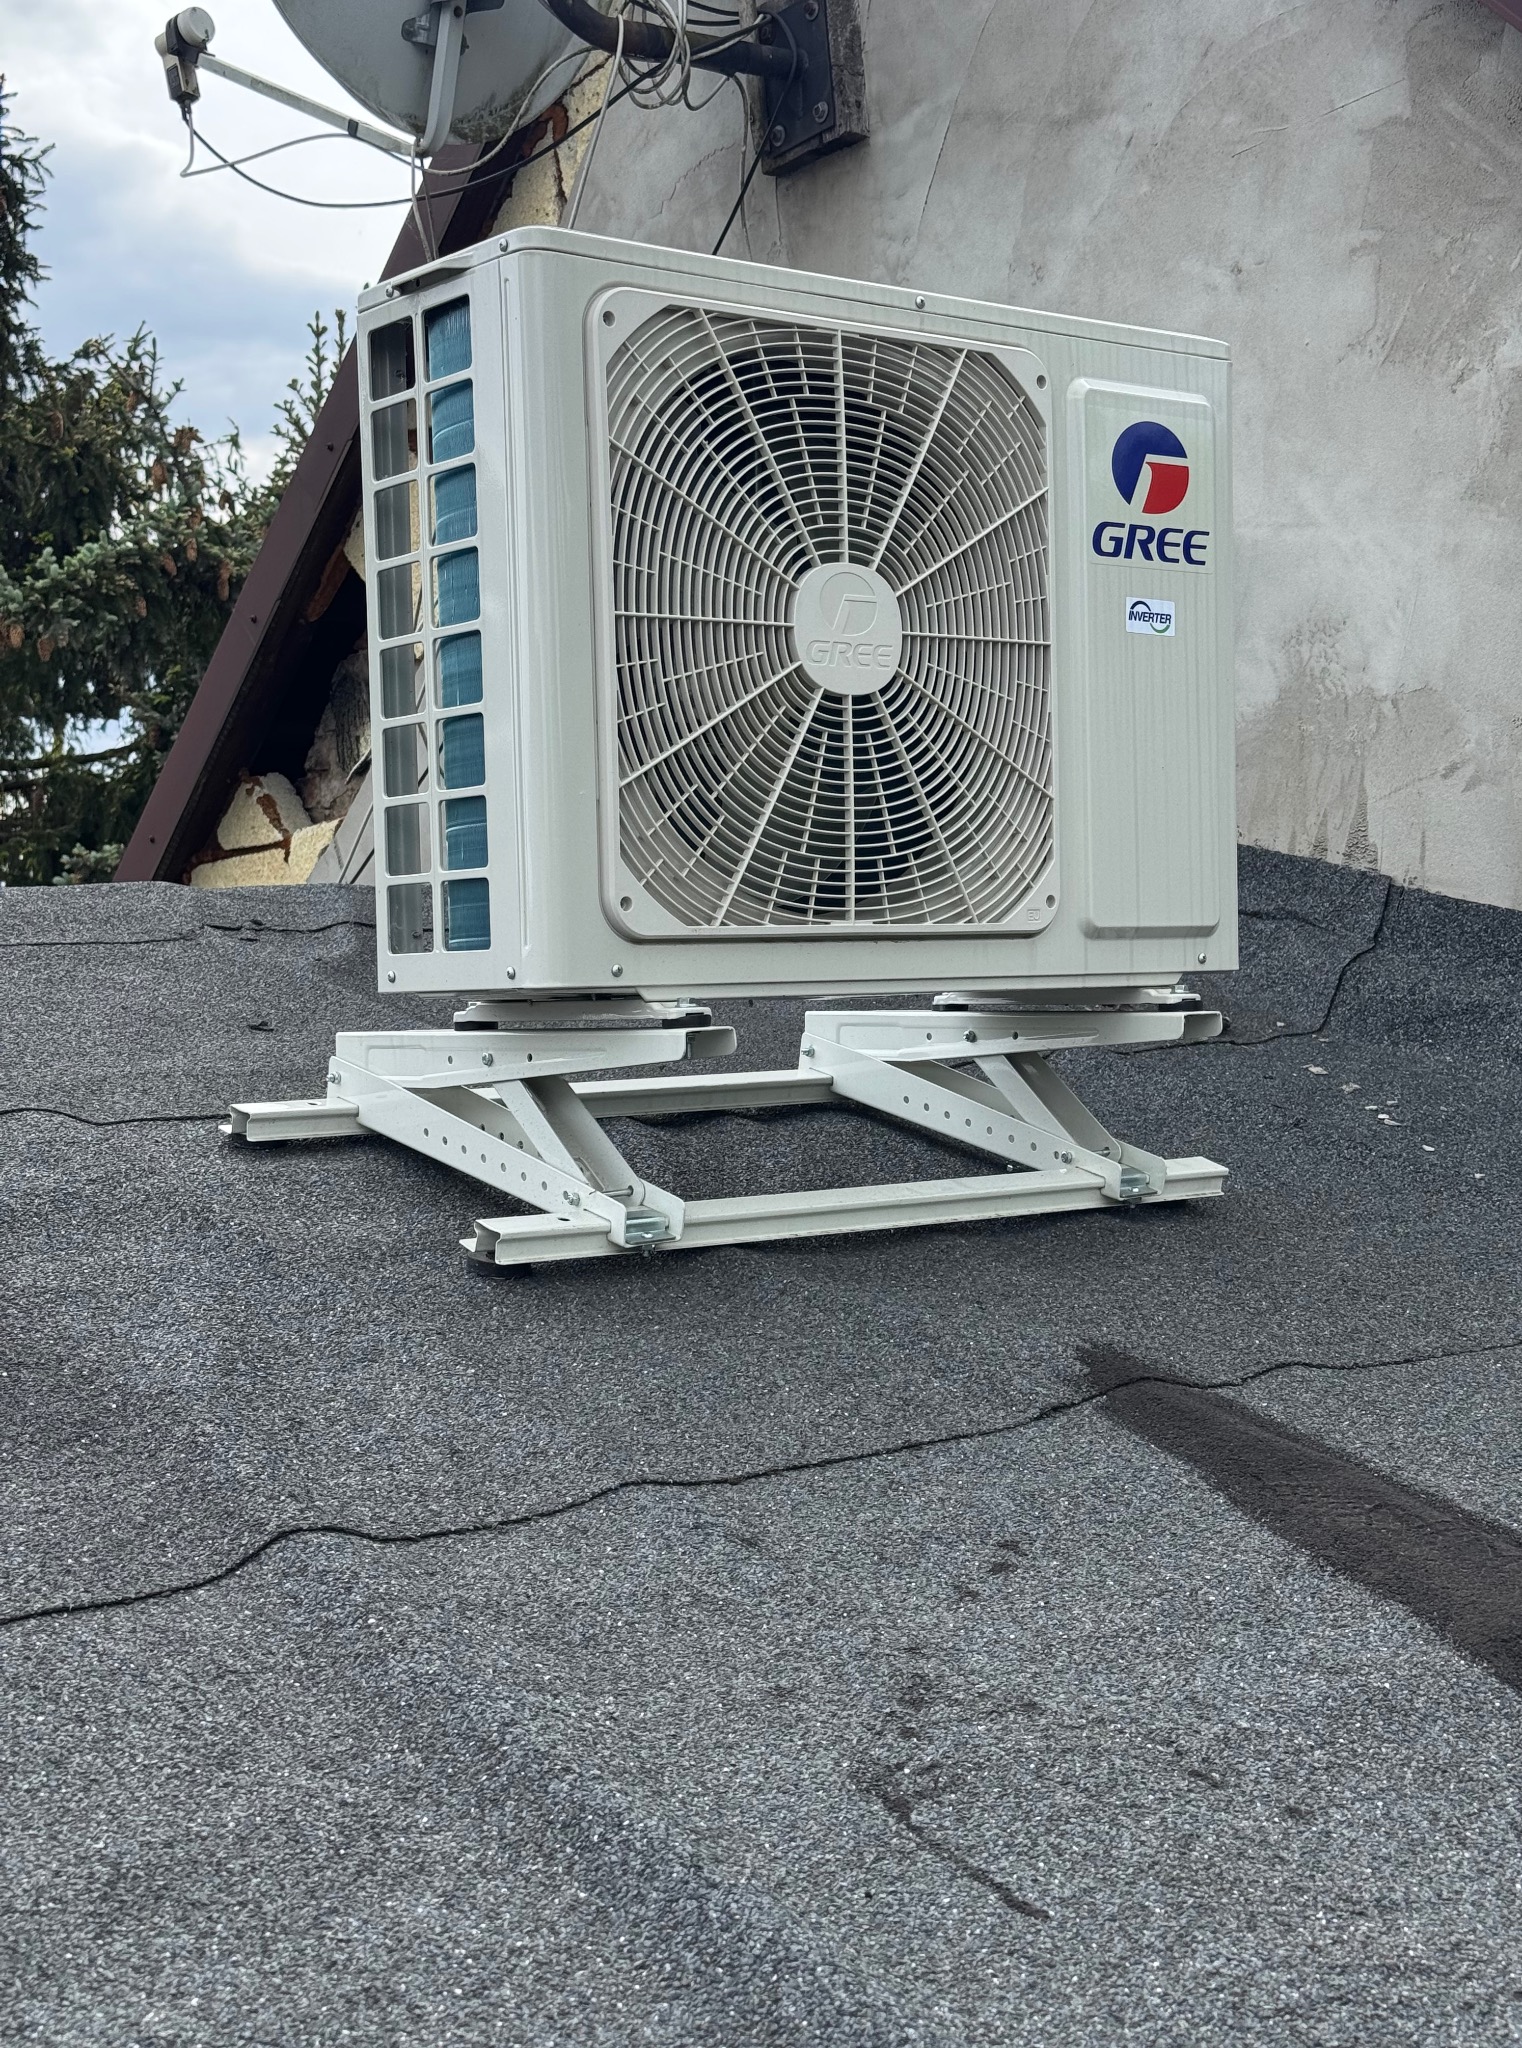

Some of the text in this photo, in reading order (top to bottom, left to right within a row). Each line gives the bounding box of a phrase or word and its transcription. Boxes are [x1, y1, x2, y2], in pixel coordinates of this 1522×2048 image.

[1092, 521, 1210, 566] GREE
[1128, 610, 1172, 624] INVERTER
[805, 639, 894, 670] GREE
